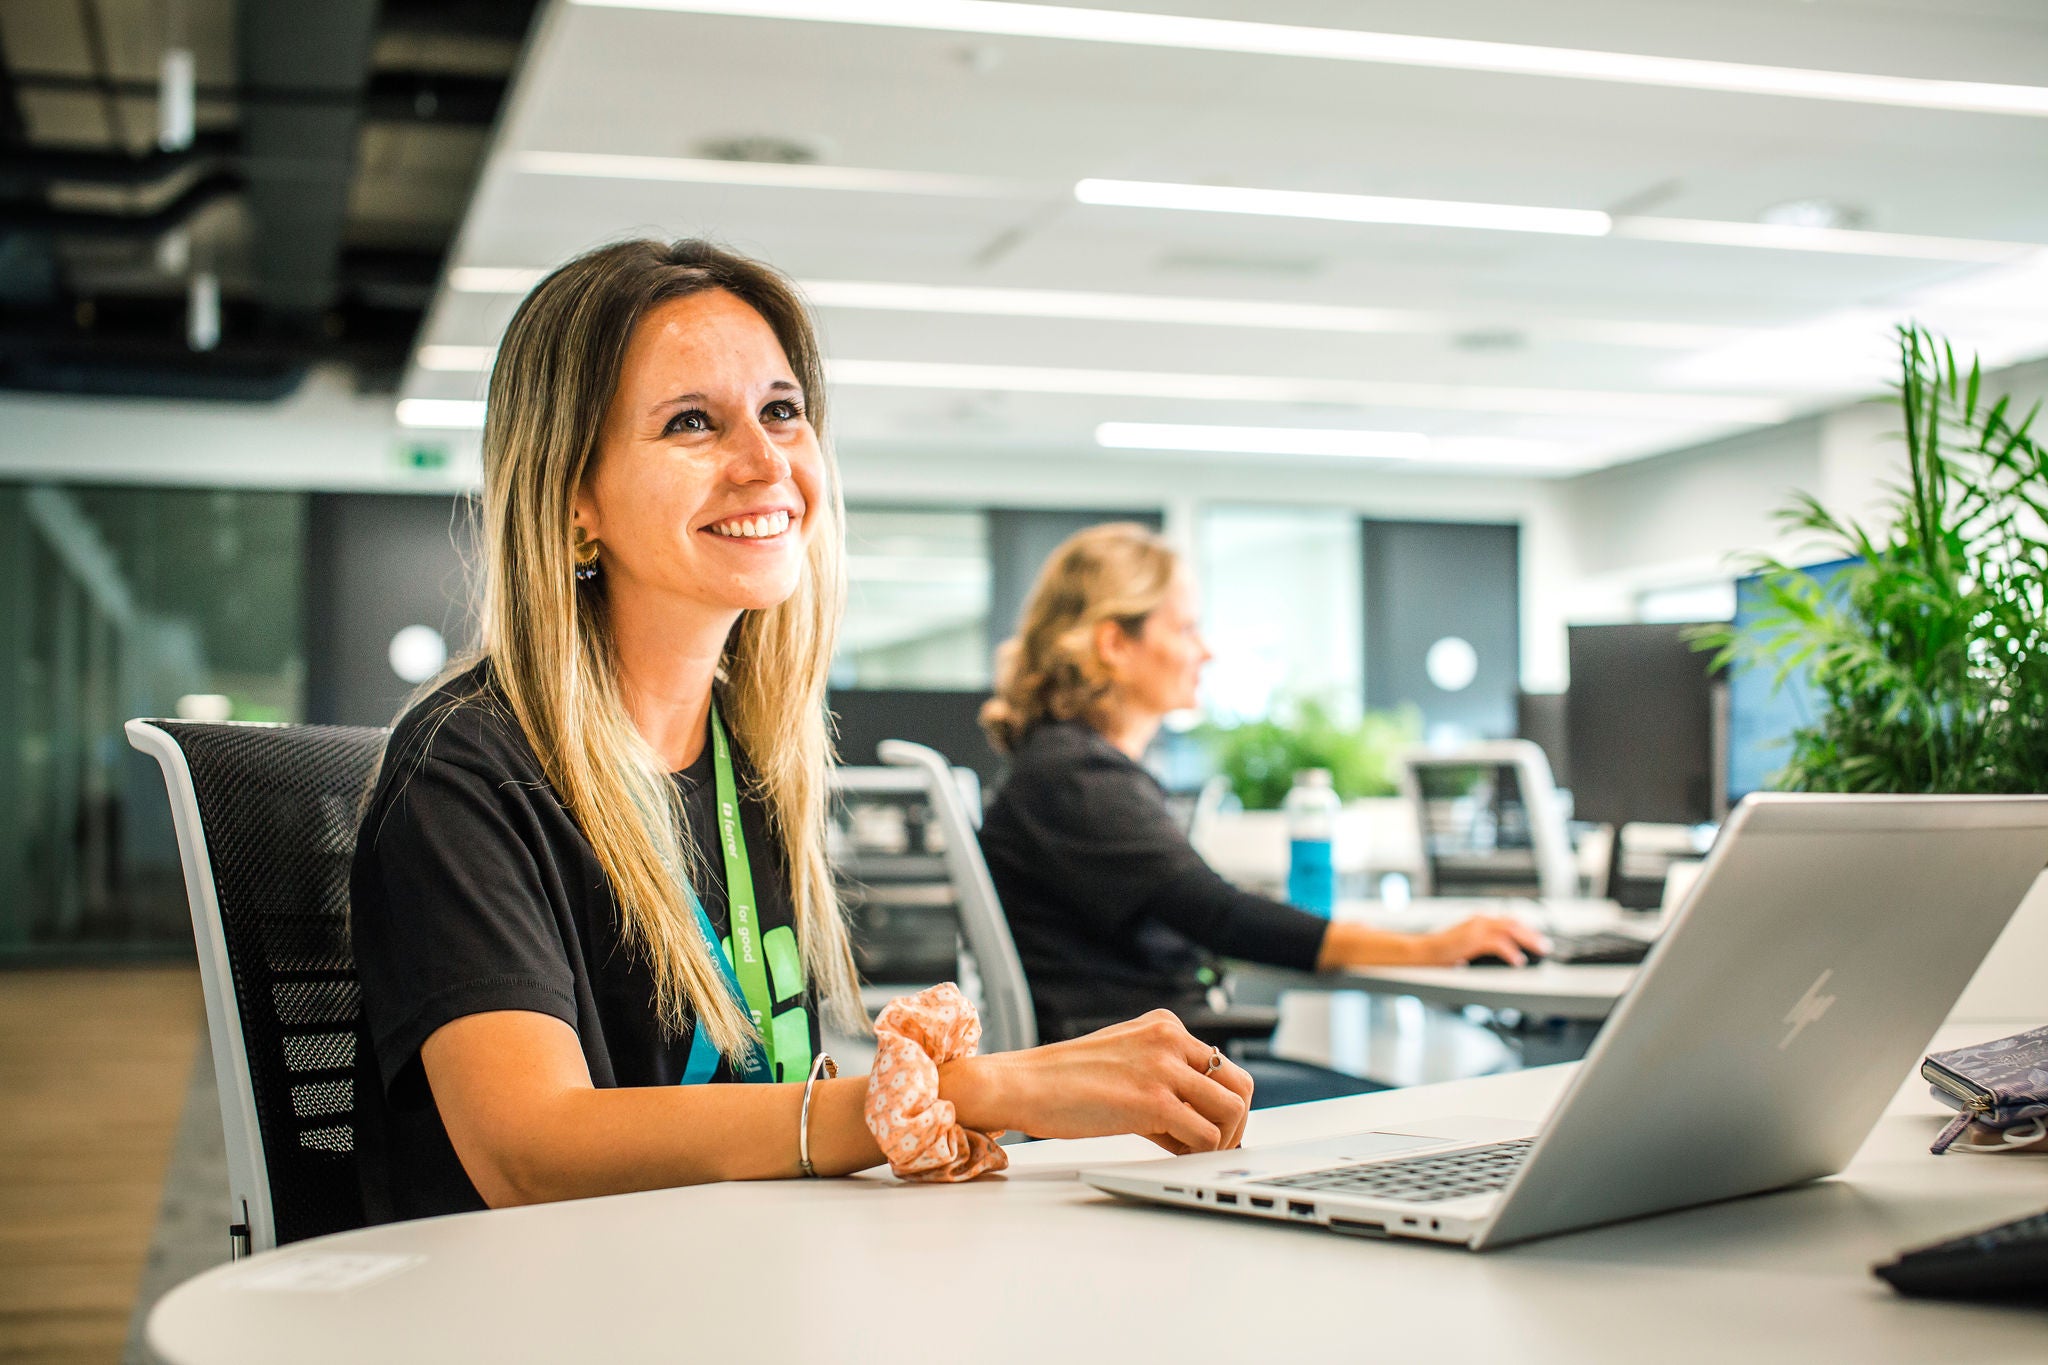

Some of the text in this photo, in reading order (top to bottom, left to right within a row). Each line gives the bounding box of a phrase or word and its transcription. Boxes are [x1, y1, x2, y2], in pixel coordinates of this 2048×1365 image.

[724, 818, 738, 859] ferrer
[738, 905, 756, 963] for good
